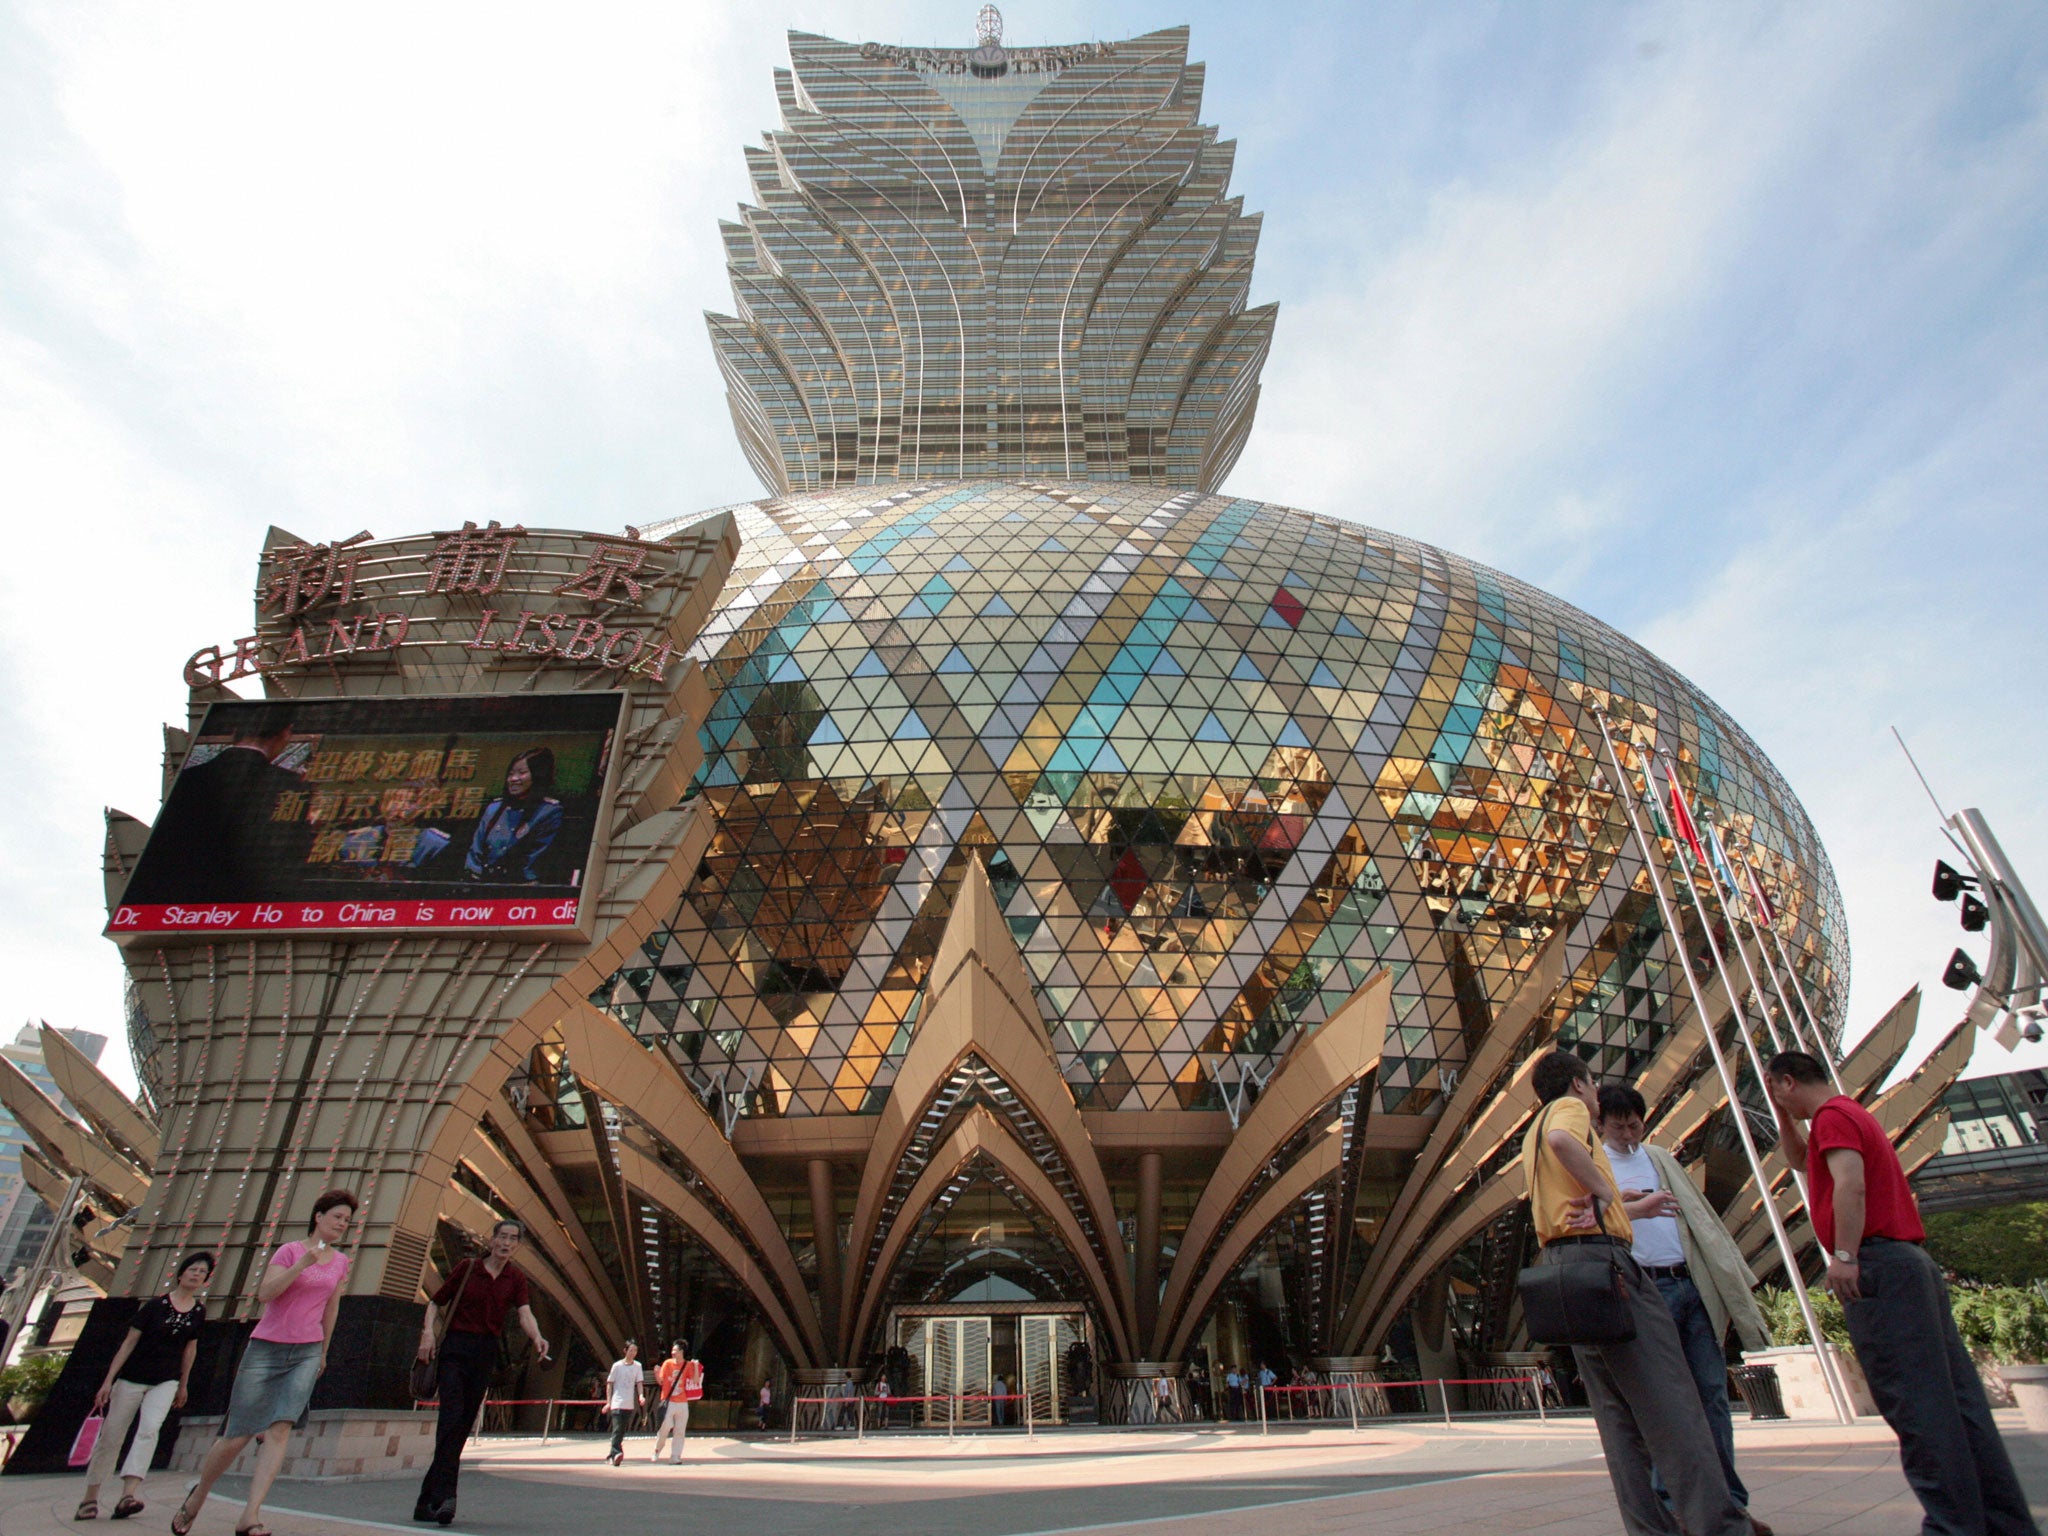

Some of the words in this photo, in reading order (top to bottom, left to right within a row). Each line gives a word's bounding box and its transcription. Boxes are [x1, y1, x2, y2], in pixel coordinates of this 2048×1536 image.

[259, 520, 676, 618] 新葡京
[183, 611, 410, 688] GRAND
[467, 609, 674, 682] LISBOA
[114, 907, 141, 925] Dr.
[162, 906, 240, 926] Stanley
[252, 905, 283, 923] Ho
[302, 907, 324, 922] to
[338, 903, 396, 922] China
[416, 903, 434, 920] is
[450, 906, 493, 920] now
[508, 906, 536, 919] on
